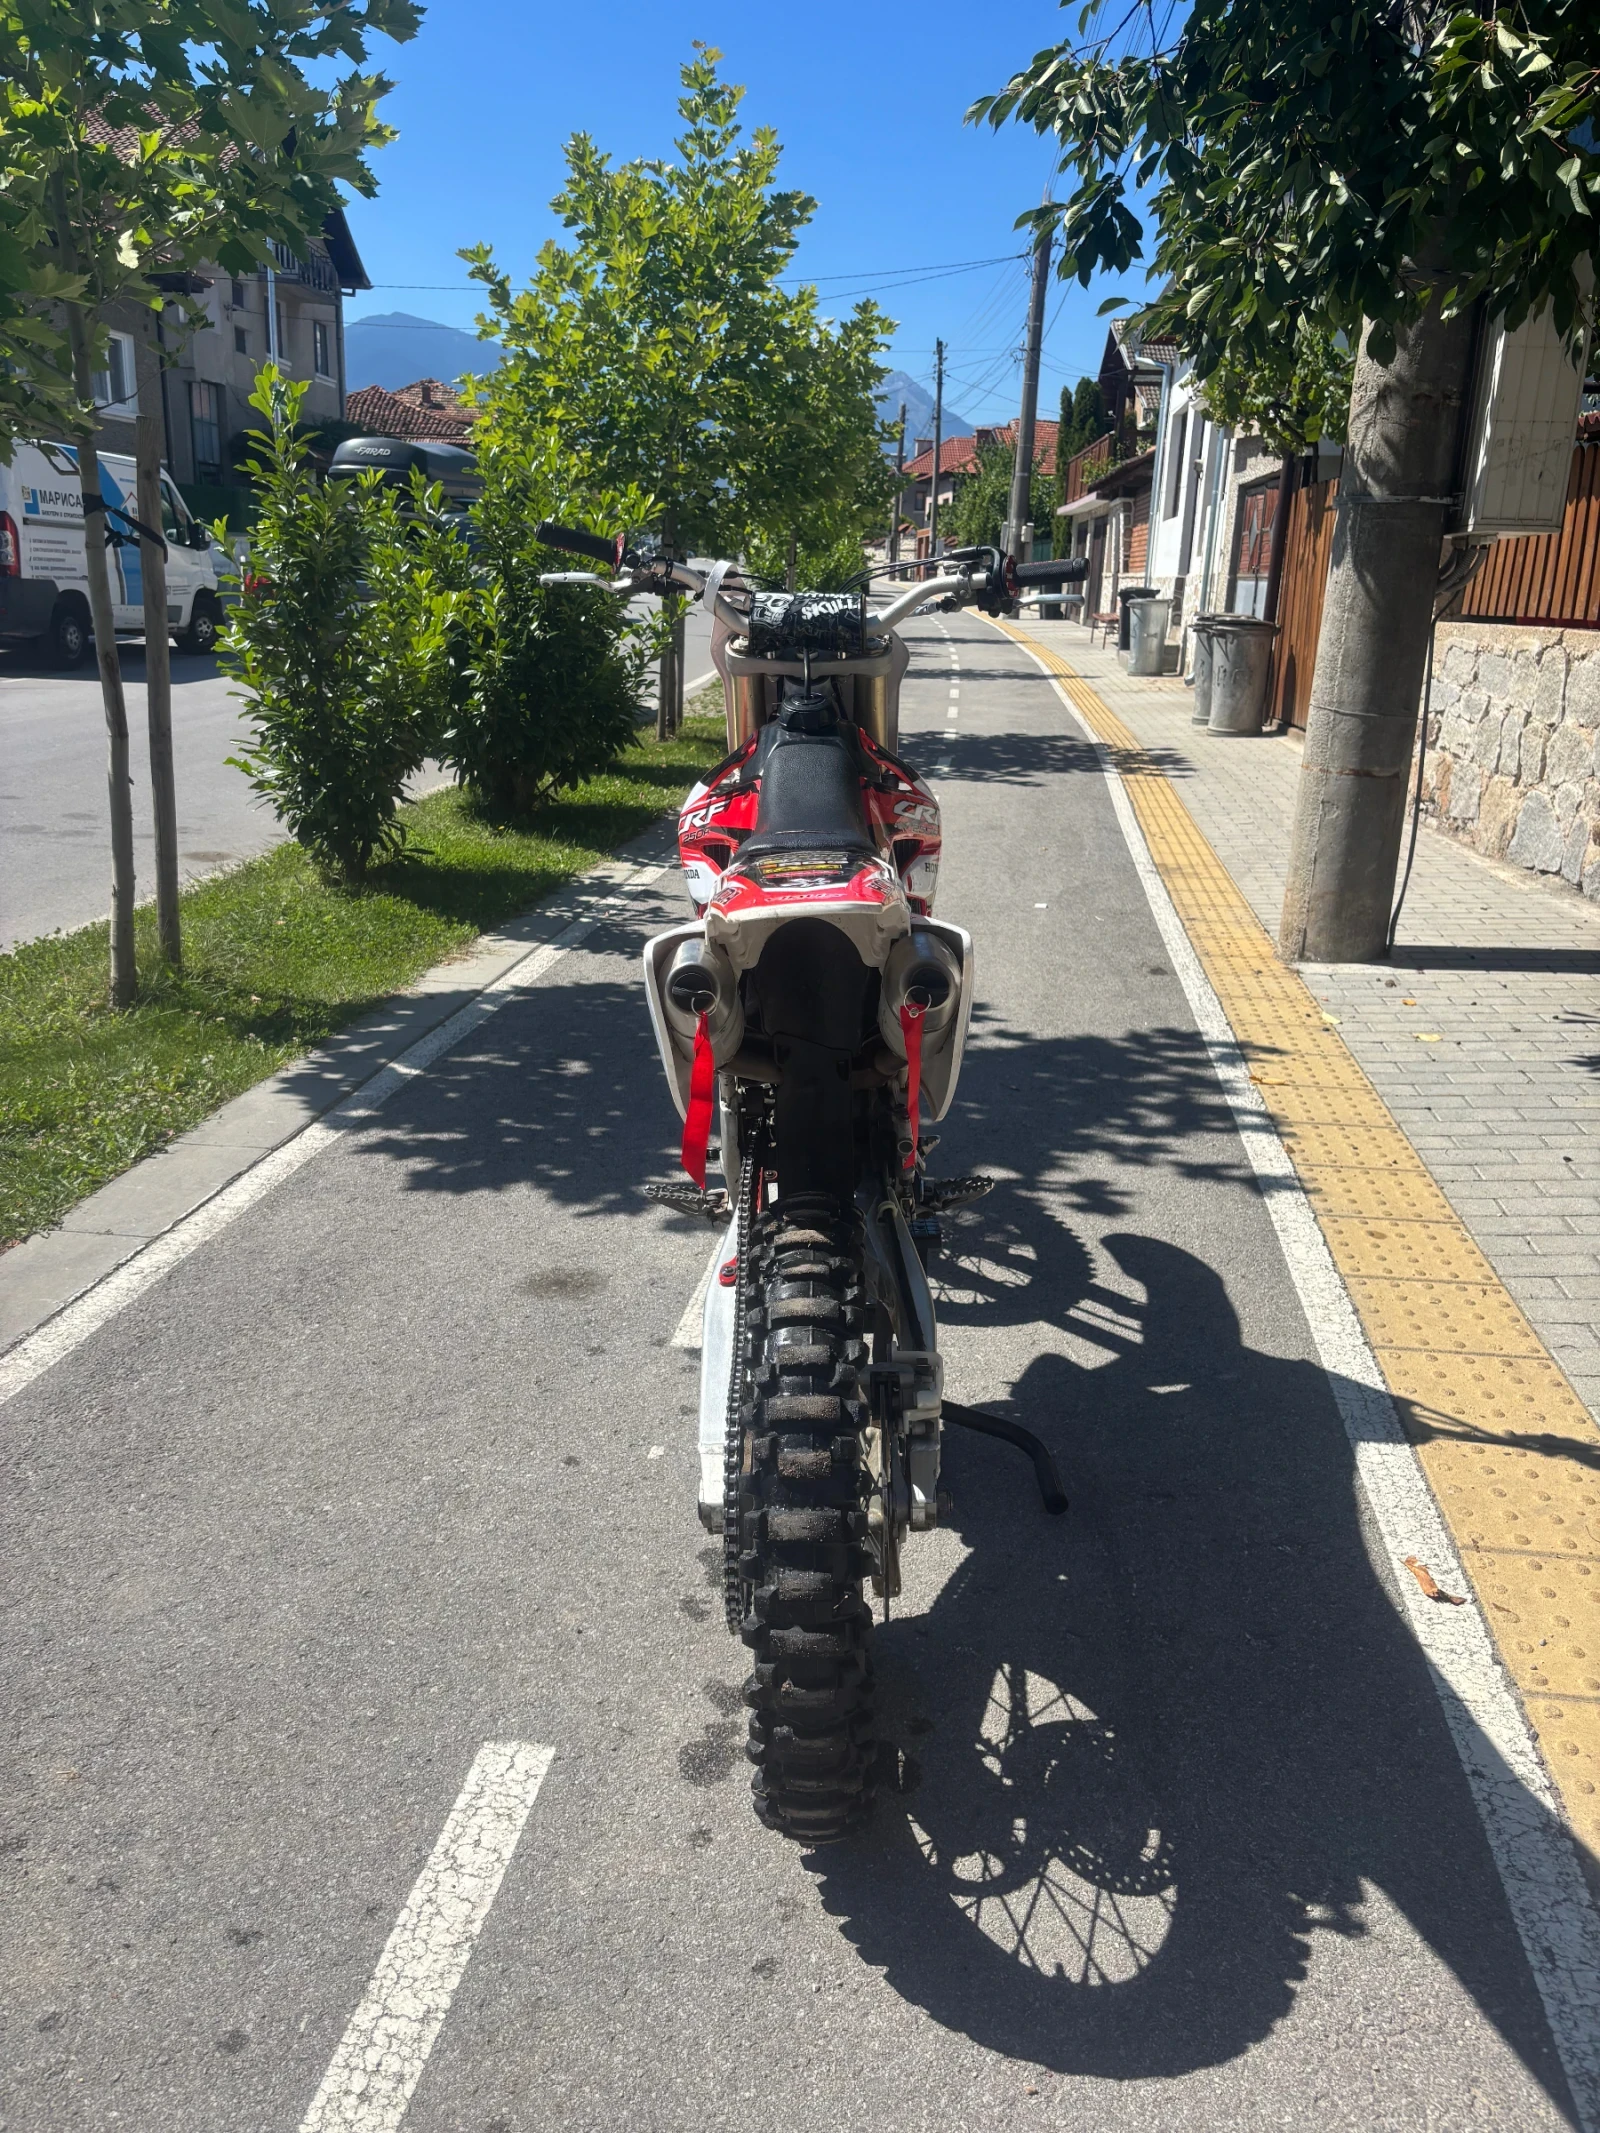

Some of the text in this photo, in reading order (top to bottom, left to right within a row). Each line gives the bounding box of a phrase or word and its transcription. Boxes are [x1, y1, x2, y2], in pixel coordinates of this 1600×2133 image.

[355, 447, 391, 456] FARAD
[801, 599, 861, 620] SKULL
[893, 800, 940, 826] CR
